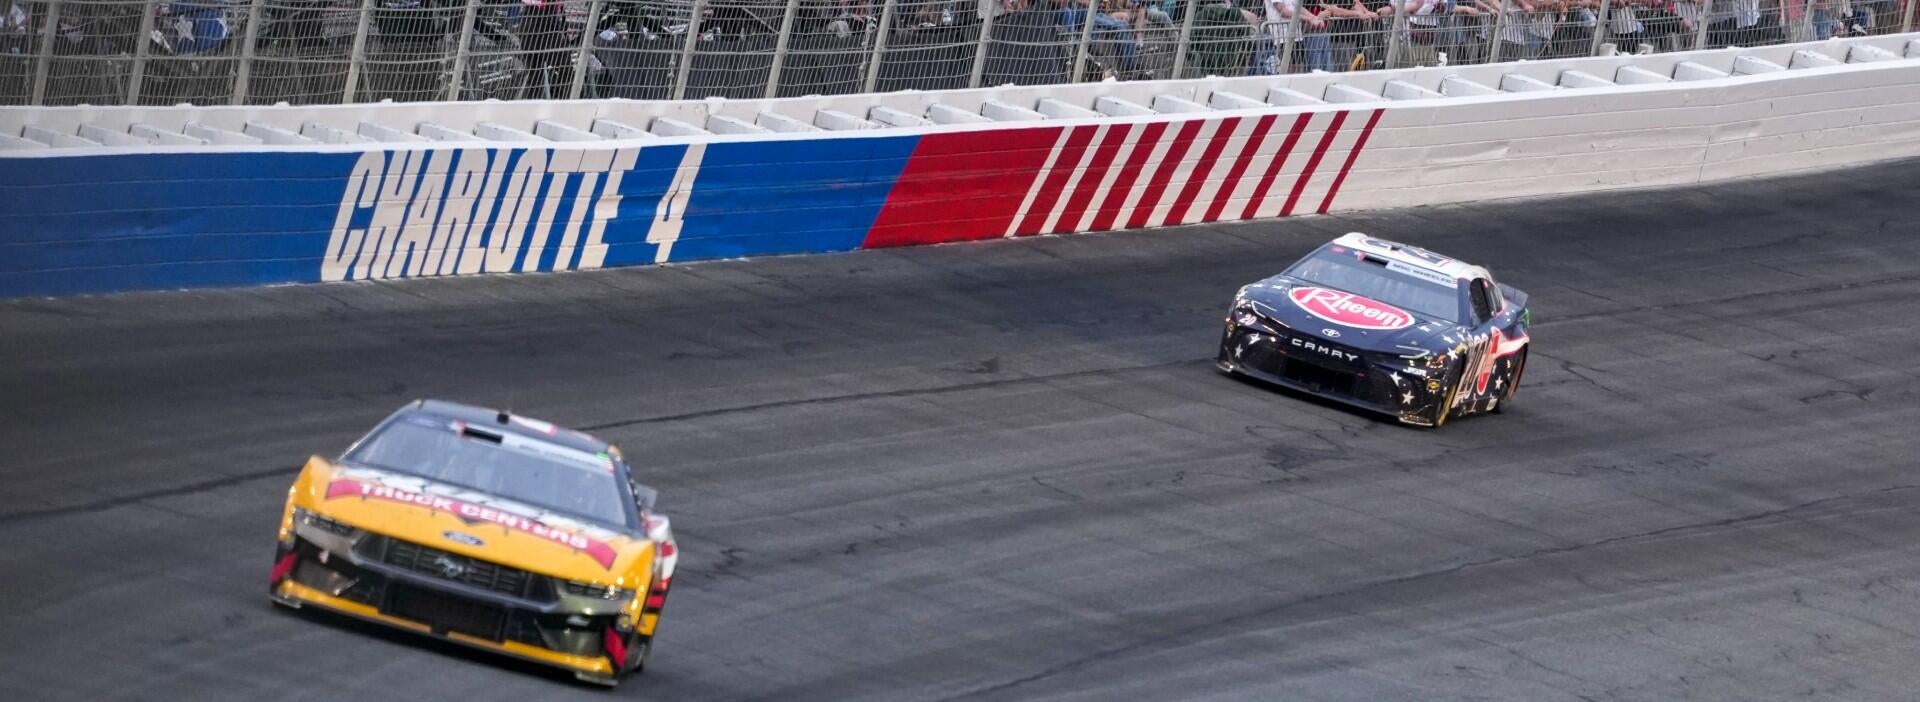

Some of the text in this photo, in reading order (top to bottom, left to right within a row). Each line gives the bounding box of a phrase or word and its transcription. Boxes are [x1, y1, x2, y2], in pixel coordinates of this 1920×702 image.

[321, 143, 708, 282] CHARLOTTE 4
[1239, 313, 1257, 326] 20
[1301, 287, 1405, 328] Rheem
[1291, 338, 1360, 361] CAMRY
[359, 483, 589, 549] TRUCK CENTERS
